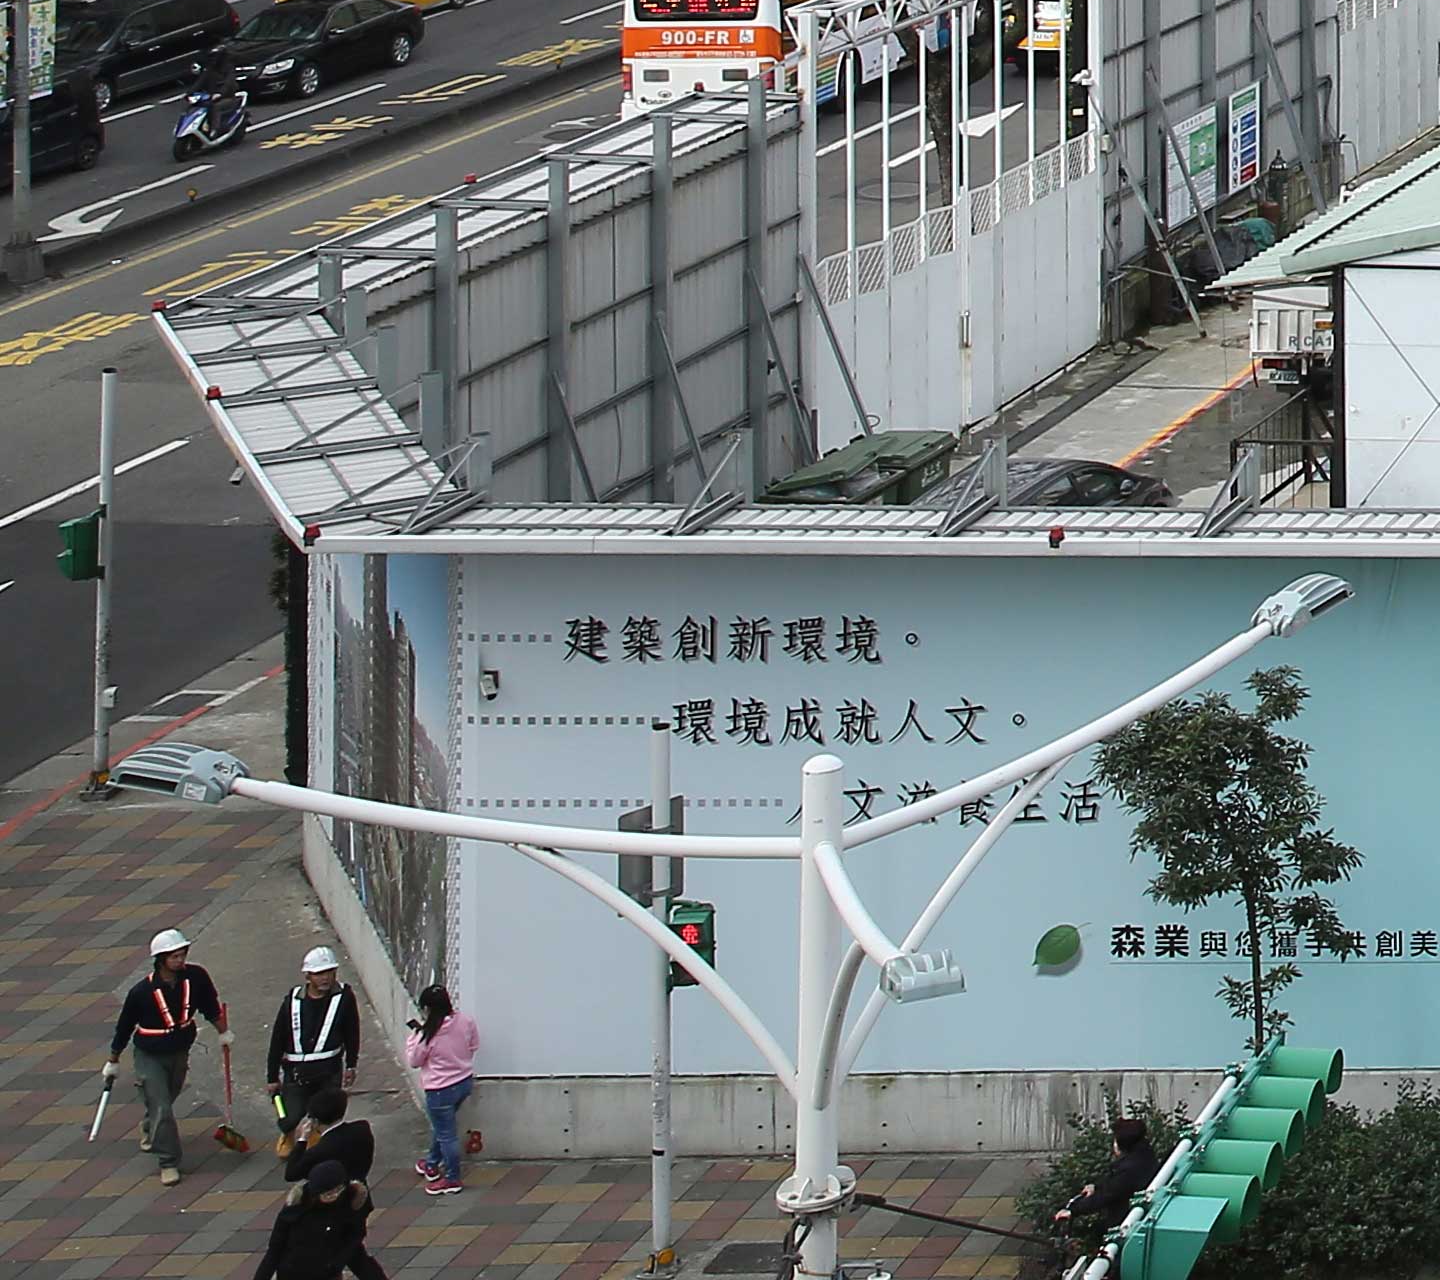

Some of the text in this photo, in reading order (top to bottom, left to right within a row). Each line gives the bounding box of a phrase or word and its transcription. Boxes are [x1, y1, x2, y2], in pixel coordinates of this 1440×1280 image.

[661, 30, 730, 46] 900-FR
[562, 614, 921, 664] 建築創新環境。
[671, 697, 1030, 746] 環境成就人文。
